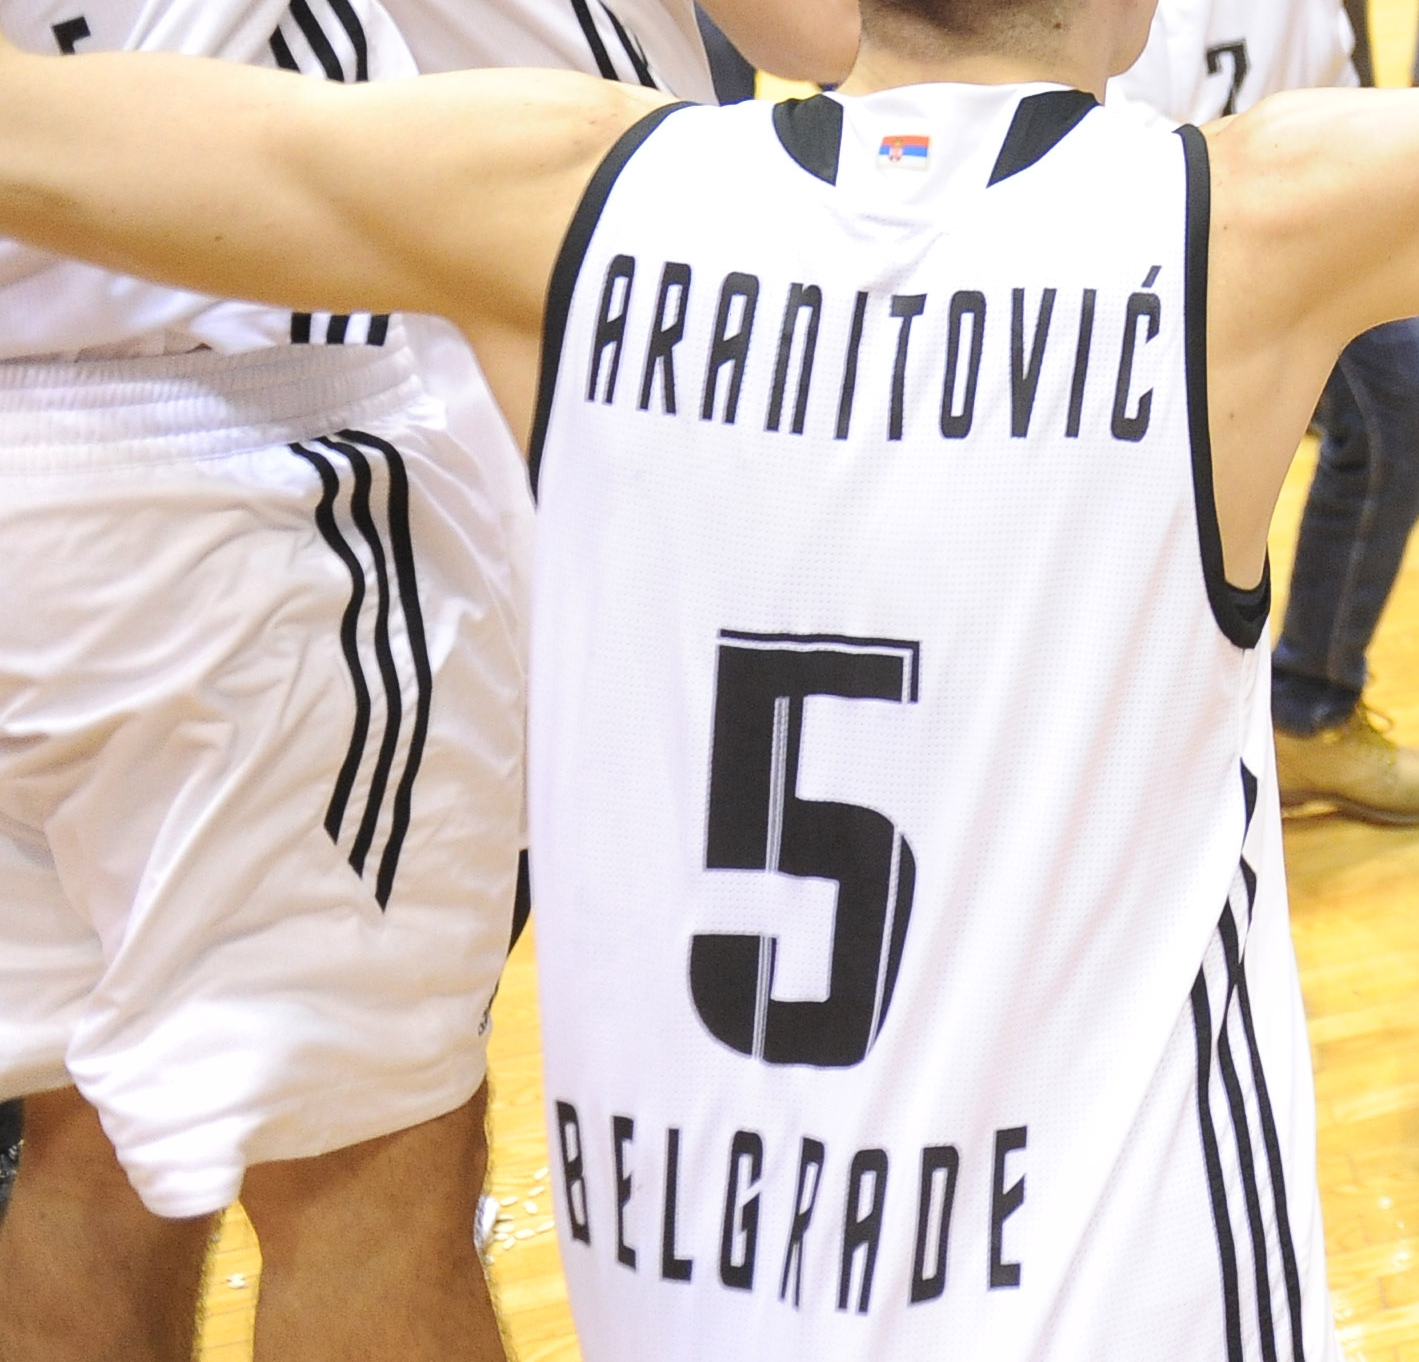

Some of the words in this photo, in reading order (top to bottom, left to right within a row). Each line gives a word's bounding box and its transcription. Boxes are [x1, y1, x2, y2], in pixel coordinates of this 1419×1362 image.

[585, 253, 1161, 443] ARANITOVIĆ
[689, 628, 921, 1070] 5
[553, 1098, 1029, 1315] BELGRADE
